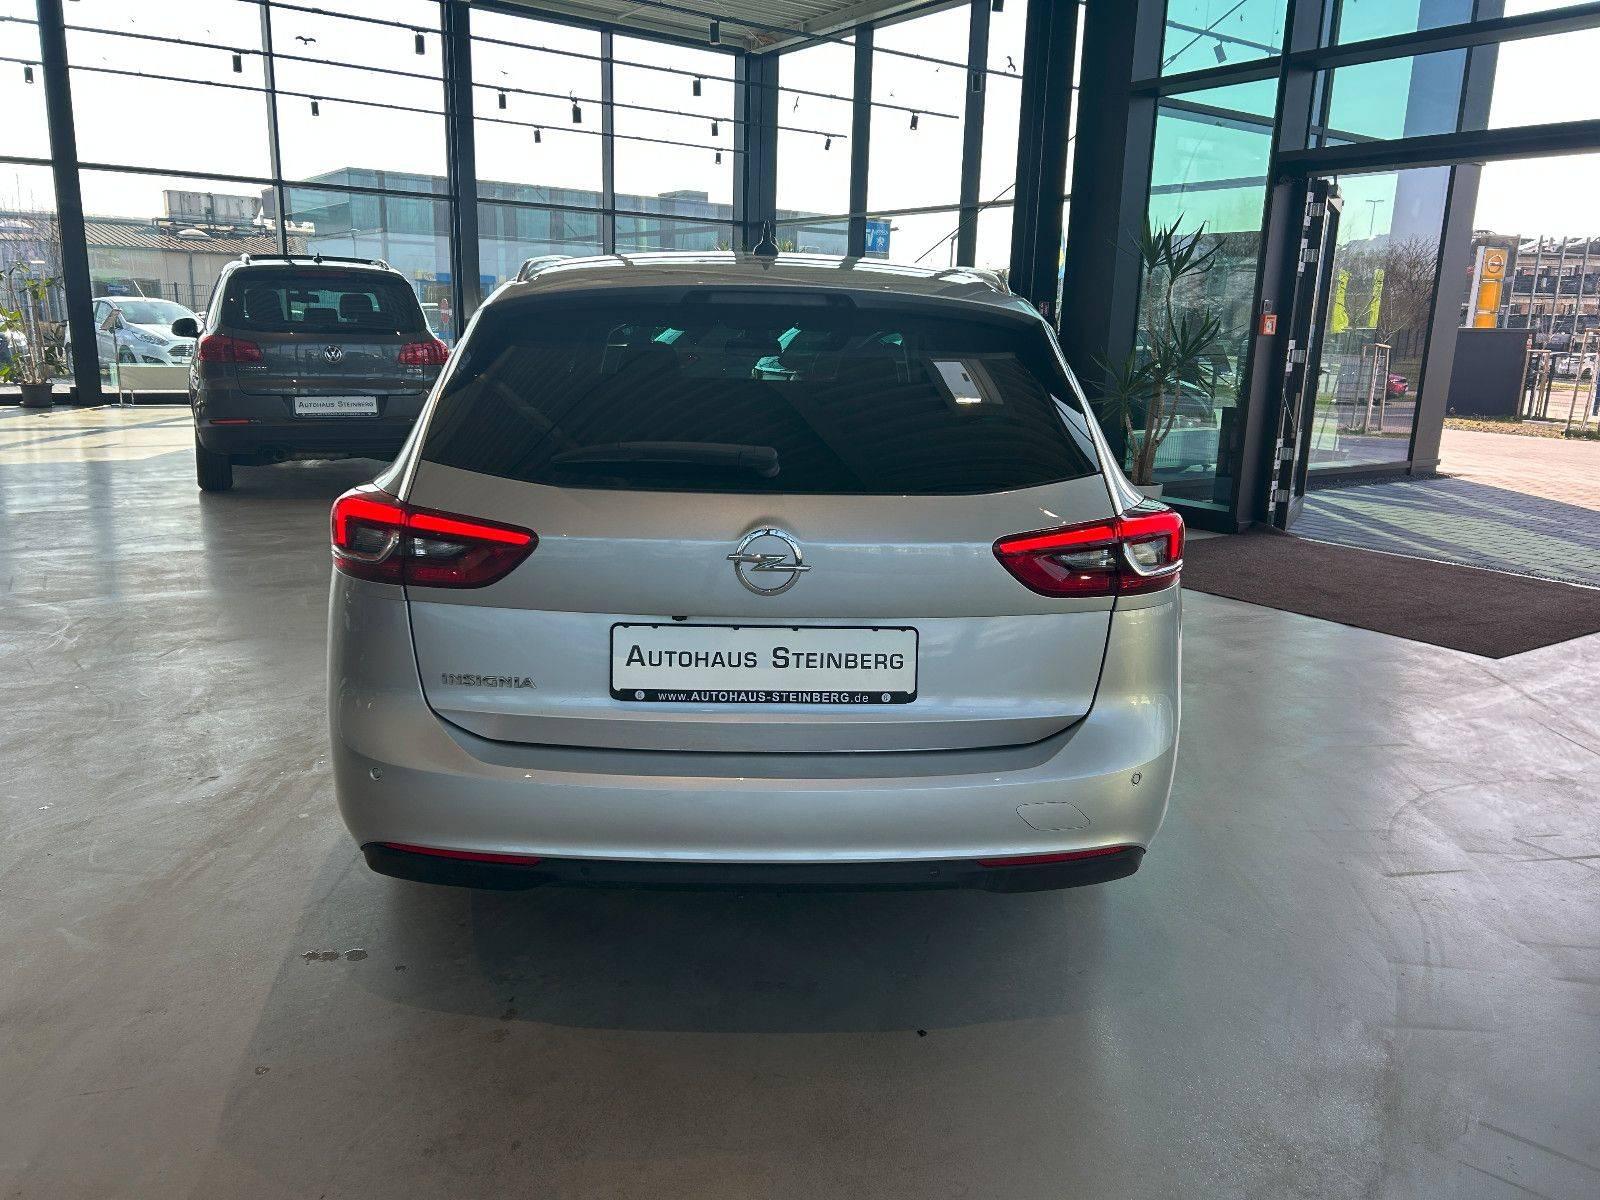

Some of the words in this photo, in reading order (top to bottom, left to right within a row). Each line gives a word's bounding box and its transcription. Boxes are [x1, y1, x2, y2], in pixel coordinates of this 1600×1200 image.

[625, 645, 758, 669] AUTOHAUS
[771, 646, 905, 670] STEINBERG
[441, 672, 537, 689] INSIGNIA
[657, 691, 870, 704] www.AUTOHAUS-STEINBERG.de
